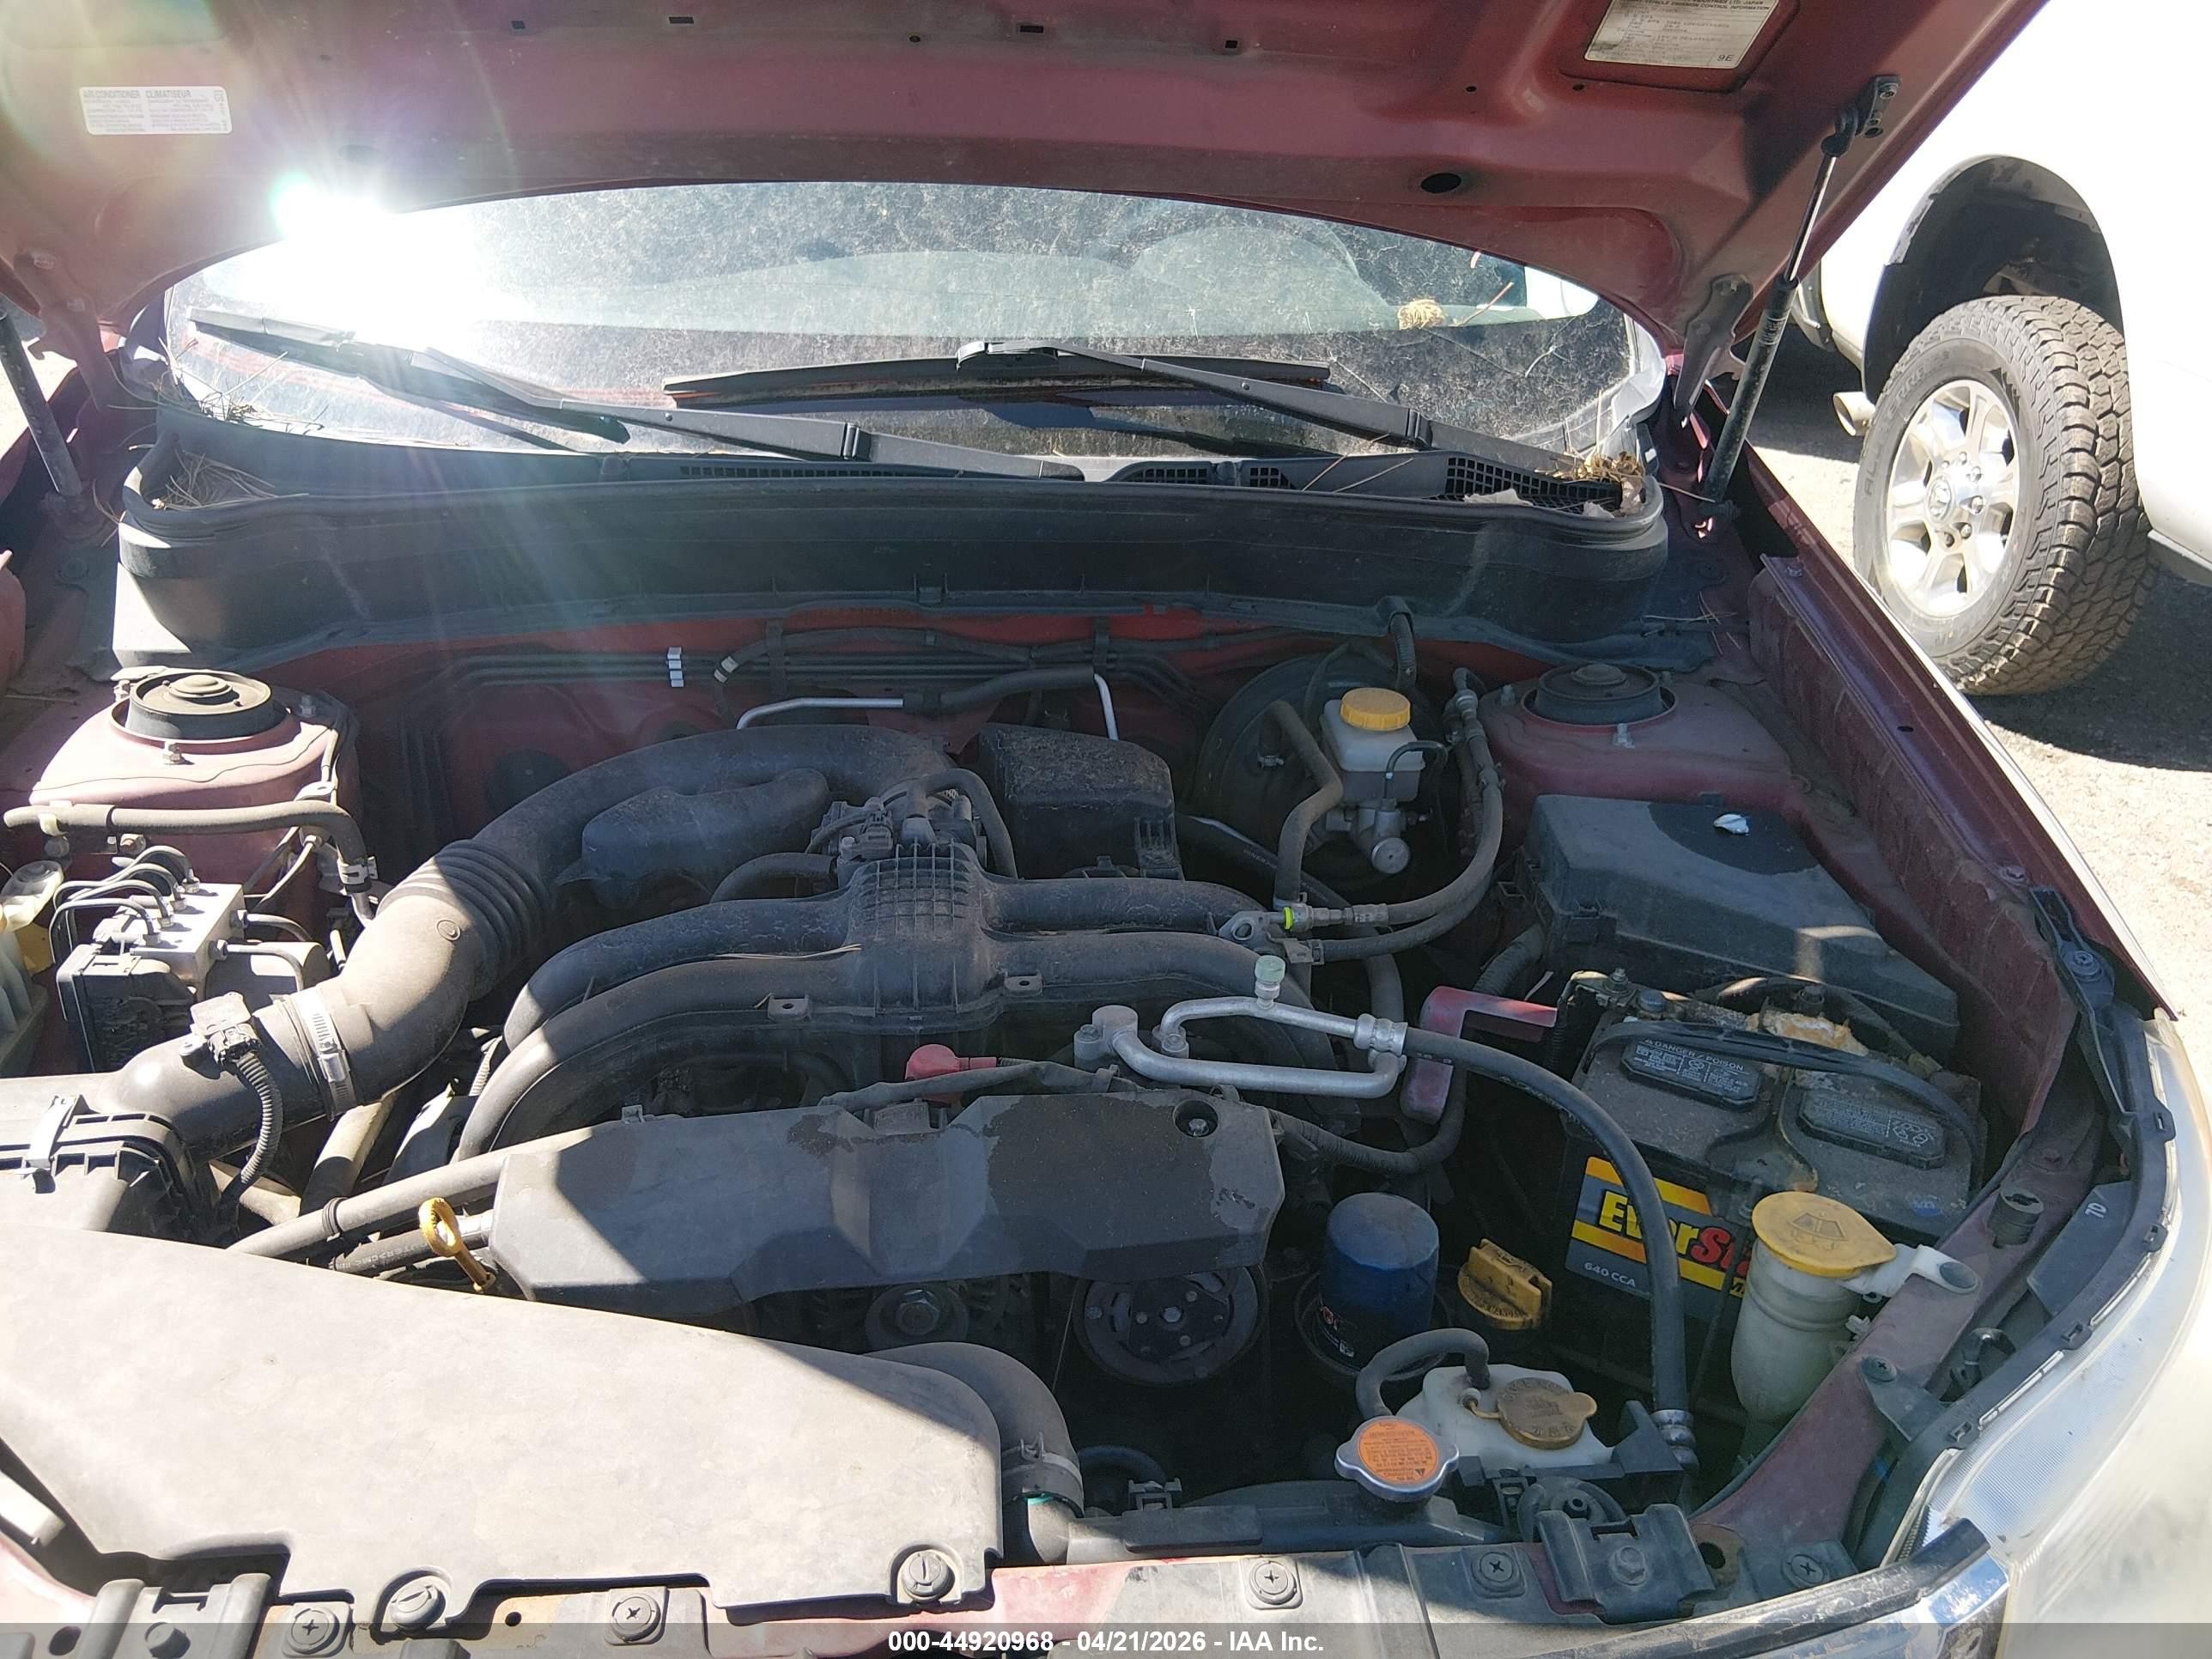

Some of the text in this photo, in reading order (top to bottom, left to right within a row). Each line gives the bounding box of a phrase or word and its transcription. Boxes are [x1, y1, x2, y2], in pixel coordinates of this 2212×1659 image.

[1705, 1055, 1744, 1071] POISON
[1583, 1261, 1636, 1287] 640 CCA
